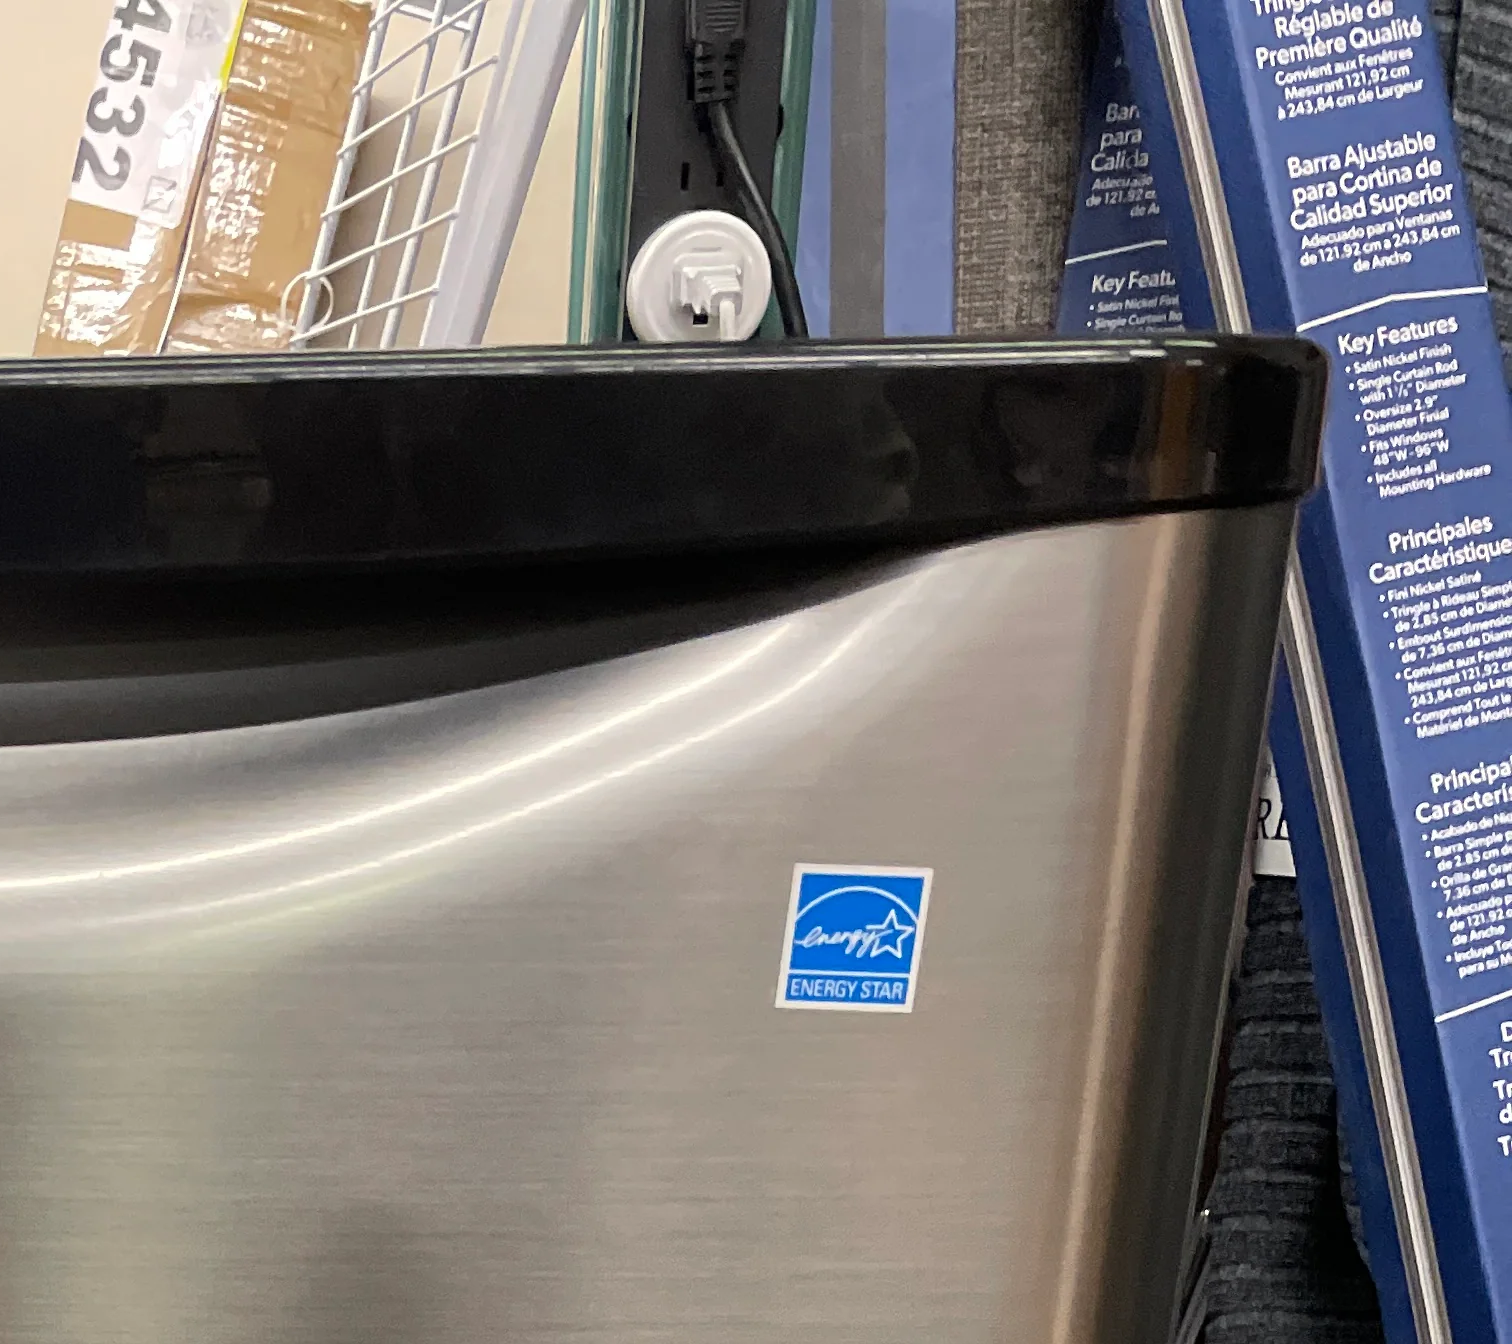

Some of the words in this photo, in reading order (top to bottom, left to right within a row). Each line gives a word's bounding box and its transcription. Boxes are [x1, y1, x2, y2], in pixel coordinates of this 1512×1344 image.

[1274, 3, 1364, 41] Réglable
[1367, 0, 1394, 19] de
[1255, 36, 1347, 69] Première
[1349, 15, 1423, 49] Qualité
[1275, 62, 1333, 86] Convient
[1334, 58, 1357, 74] aux
[1358, 47, 1413, 67] Fenêtres
[72, 0, 171, 191] 4532
[1285, 76, 1345, 100] Mesurant
[1389, 65, 1410, 79] cm
[1336, 93, 1356, 108] cm
[1357, 88, 1374, 104] de
[1376, 79, 1424, 100] Largeur
[1100, 128, 1143, 151] para
[1287, 153, 1341, 179] Barra
[1344, 130, 1436, 170] Ajustable
[1292, 180, 1338, 209] para
[1339, 164, 1413, 194] Cortina
[1415, 156, 1442, 180] de
[1290, 196, 1367, 230] Calidad
[1369, 182, 1454, 216] Superior
[1301, 226, 1365, 250] Adecuado
[1366, 219, 1395, 239] para
[1395, 208, 1454, 230] Ventanas
[1300, 250, 1318, 267] de
[1362, 239, 1382, 254] cm
[1383, 238, 1392, 250] a
[1440, 224, 1461, 239] cm
[1353, 257, 1371, 273] de
[1372, 251, 1413, 270] Ancho
[1091, 274, 1126, 295] Key
[1338, 332, 1374, 356] Key
[1377, 316, 1459, 348] Features
[1353, 358, 1382, 375] Satin
[1382, 350, 1418, 368] Nickel
[1419, 343, 1452, 360] Finish
[1357, 374, 1392, 391] Single
[1393, 365, 1434, 383] Curtain
[1435, 358, 1458, 374] Rod
[1360, 389, 1387, 405] with
[1415, 373, 1467, 393] Diameter
[1363, 403, 1413, 422] Oversize
[1366, 417, 1417, 437] Diameter
[1419, 407, 1449, 424] Finial
[1369, 439, 1389, 453] Fits
[1390, 428, 1444, 447] Windows
[1375, 465, 1423, 484] Includes
[1424, 459, 1437, 473] all
[1379, 478, 1434, 499] Mounting
[1435, 464, 1492, 485] Hardware
[1388, 515, 1493, 554] Principales
[1409, 579, 1445, 597] Nickel
[1391, 601, 1430, 619] Tringle
[1395, 620, 1410, 633] de
[1440, 610, 1458, 622] cm
[1459, 606, 1474, 618] de
[1402, 651, 1416, 663] de
[1447, 641, 1464, 653] cm
[1466, 636, 1480, 648] de
[1403, 659, 1454, 680] Convient
[1408, 672, 1460, 694] Mesurant
[1454, 686, 1471, 697] cm
[1473, 681, 1488, 693] de
[1413, 700, 1472, 724] Comprend
[1473, 695, 1500, 710] Tout
[1464, 715, 1479, 727] de
[1482, 848, 1499, 860] cm
[1472, 867, 1487, 880] de
[790, 978, 858, 998] ENERGY
[860, 981, 904, 1000] STAR
